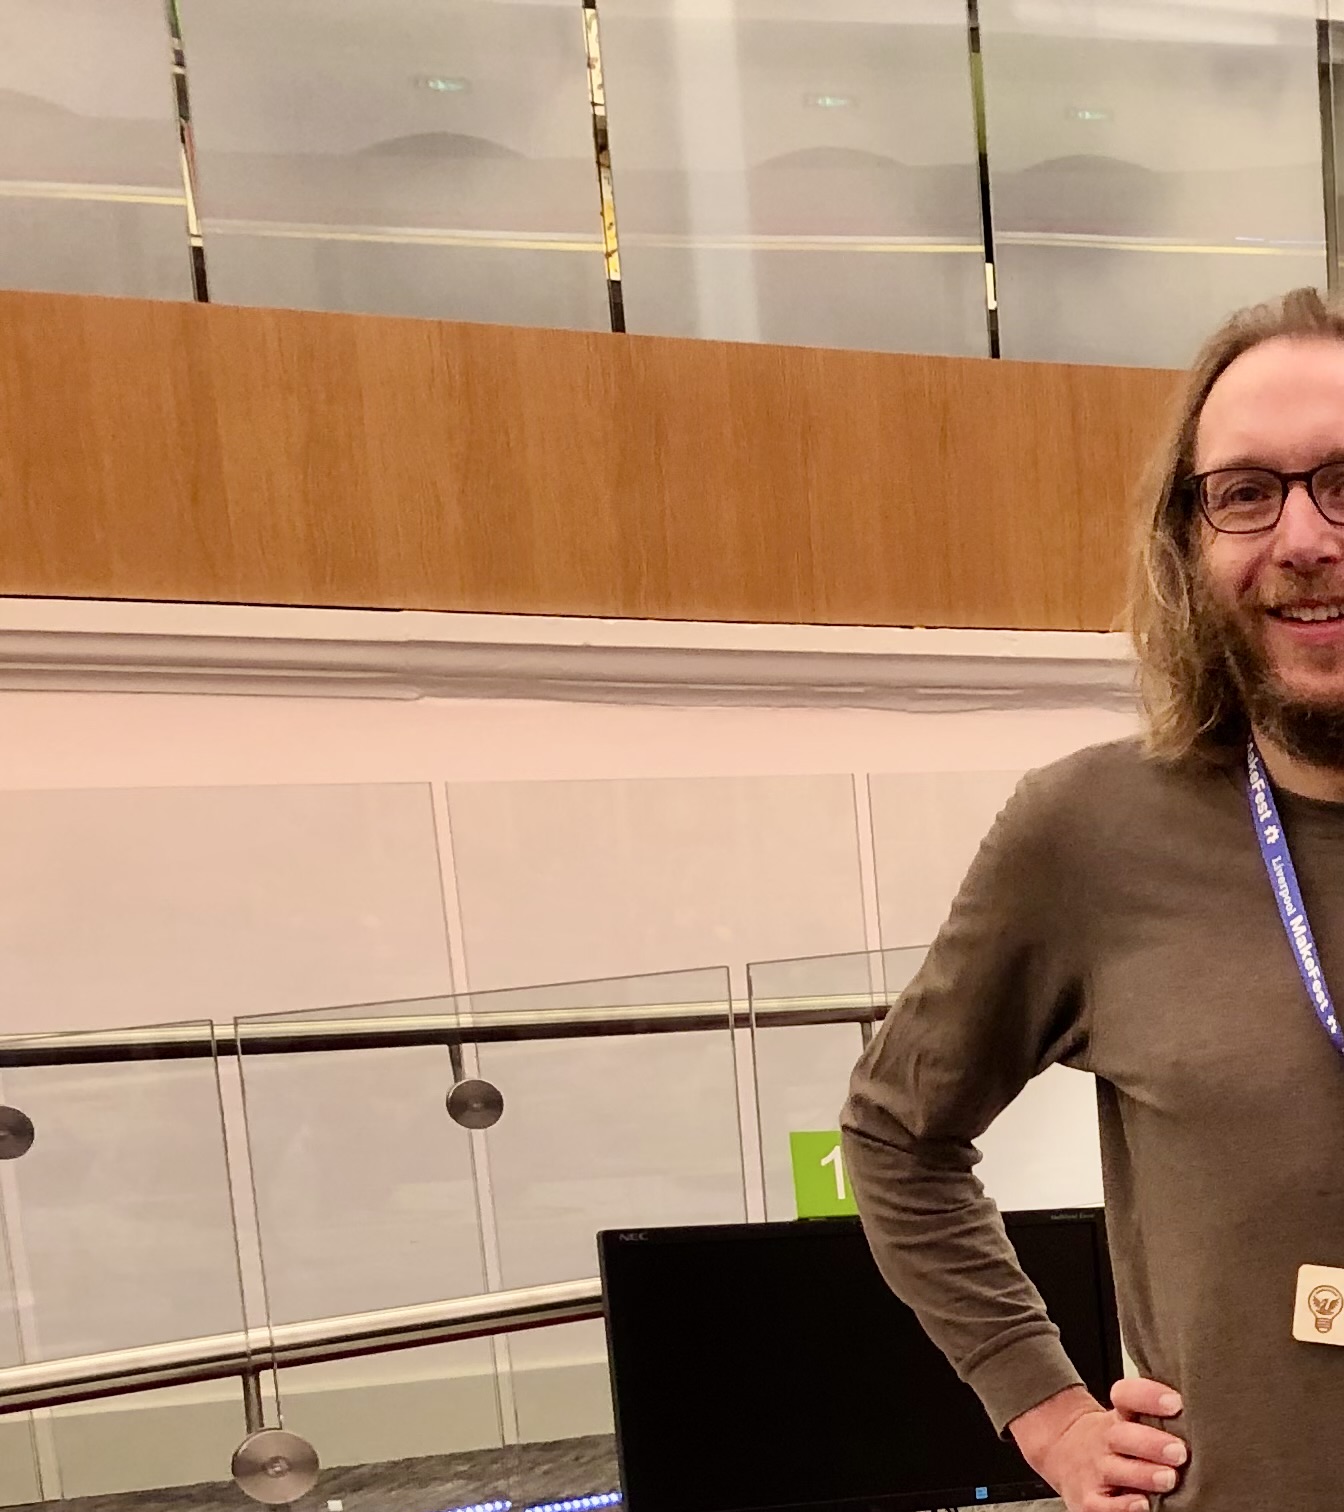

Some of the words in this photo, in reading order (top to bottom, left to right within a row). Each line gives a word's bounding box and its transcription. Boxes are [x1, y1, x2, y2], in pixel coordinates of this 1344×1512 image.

[1271, 855, 1297, 916] Liverpool
[1289, 914, 1329, 1012] MakeFest
[618, 1232, 649, 1242] NEC
